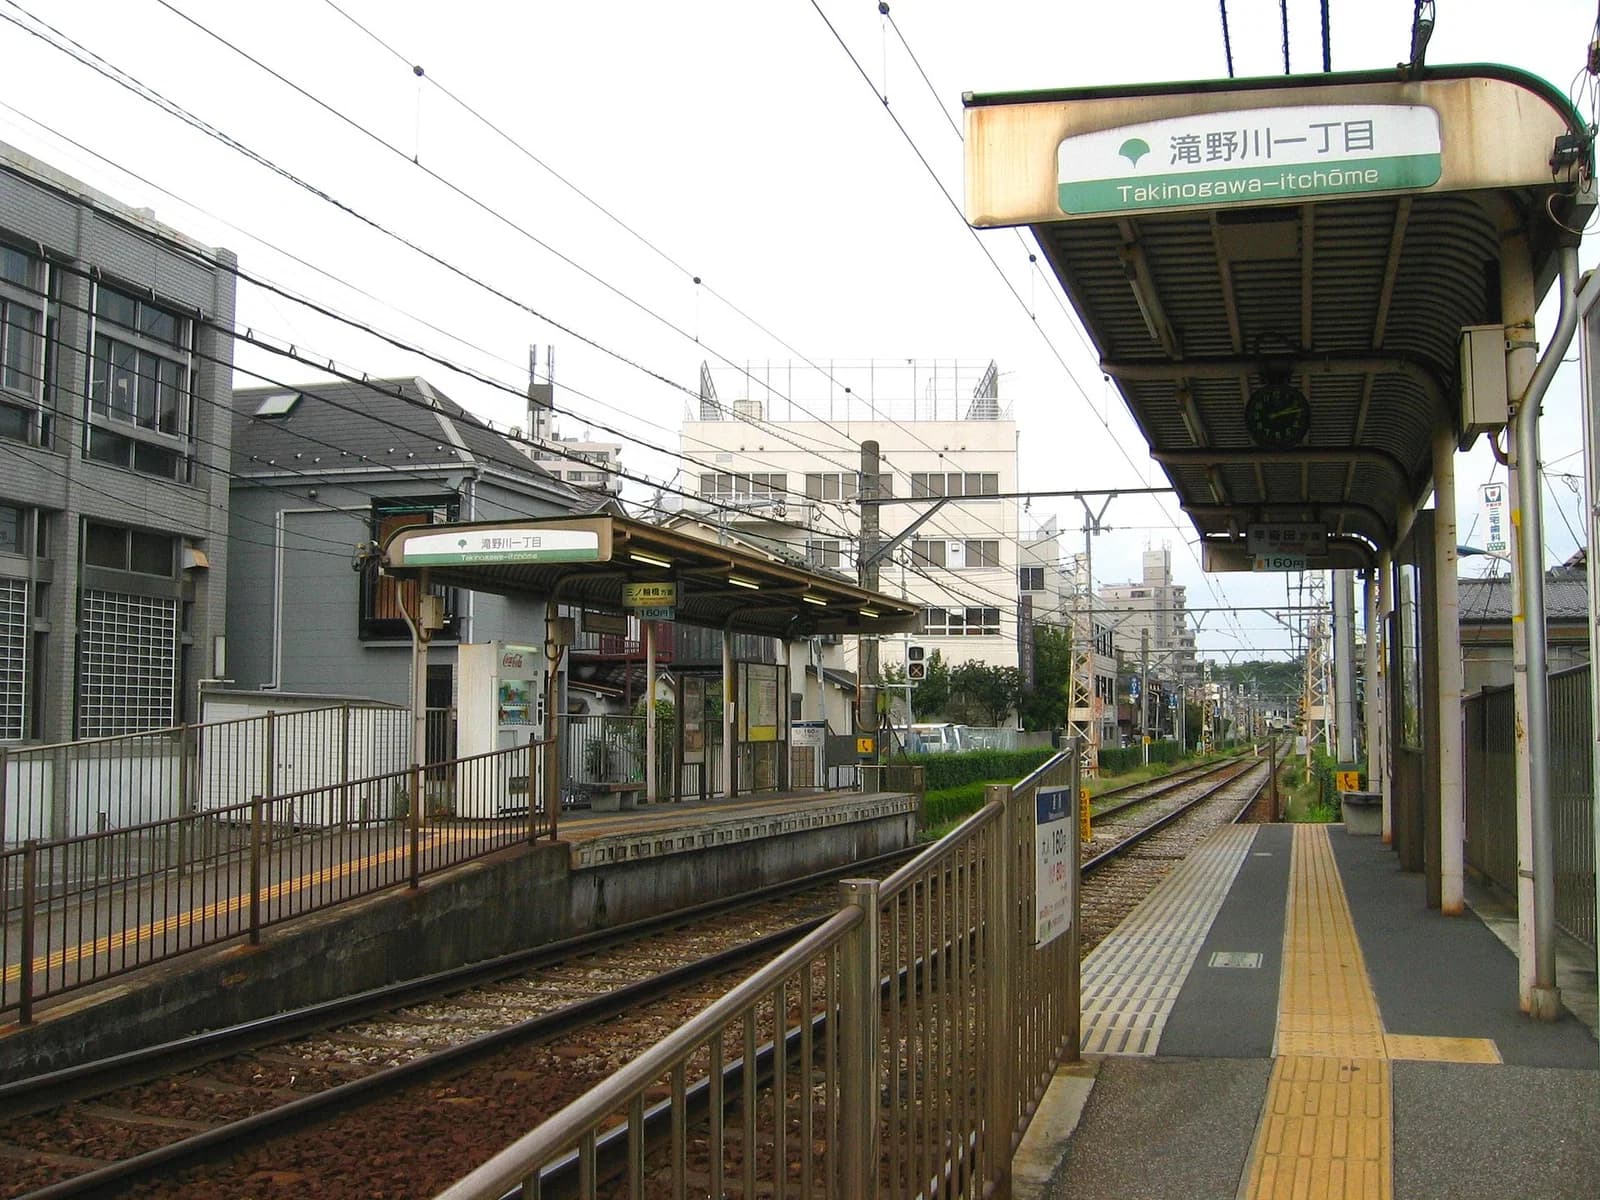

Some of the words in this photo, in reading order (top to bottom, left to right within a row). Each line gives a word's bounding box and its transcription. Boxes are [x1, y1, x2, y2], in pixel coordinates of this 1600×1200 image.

[1170, 120, 1374, 165] 滝野川一丁目
[481, 536, 542, 550] 滝野川一丁目
[1264, 558, 1304, 569] 160円
